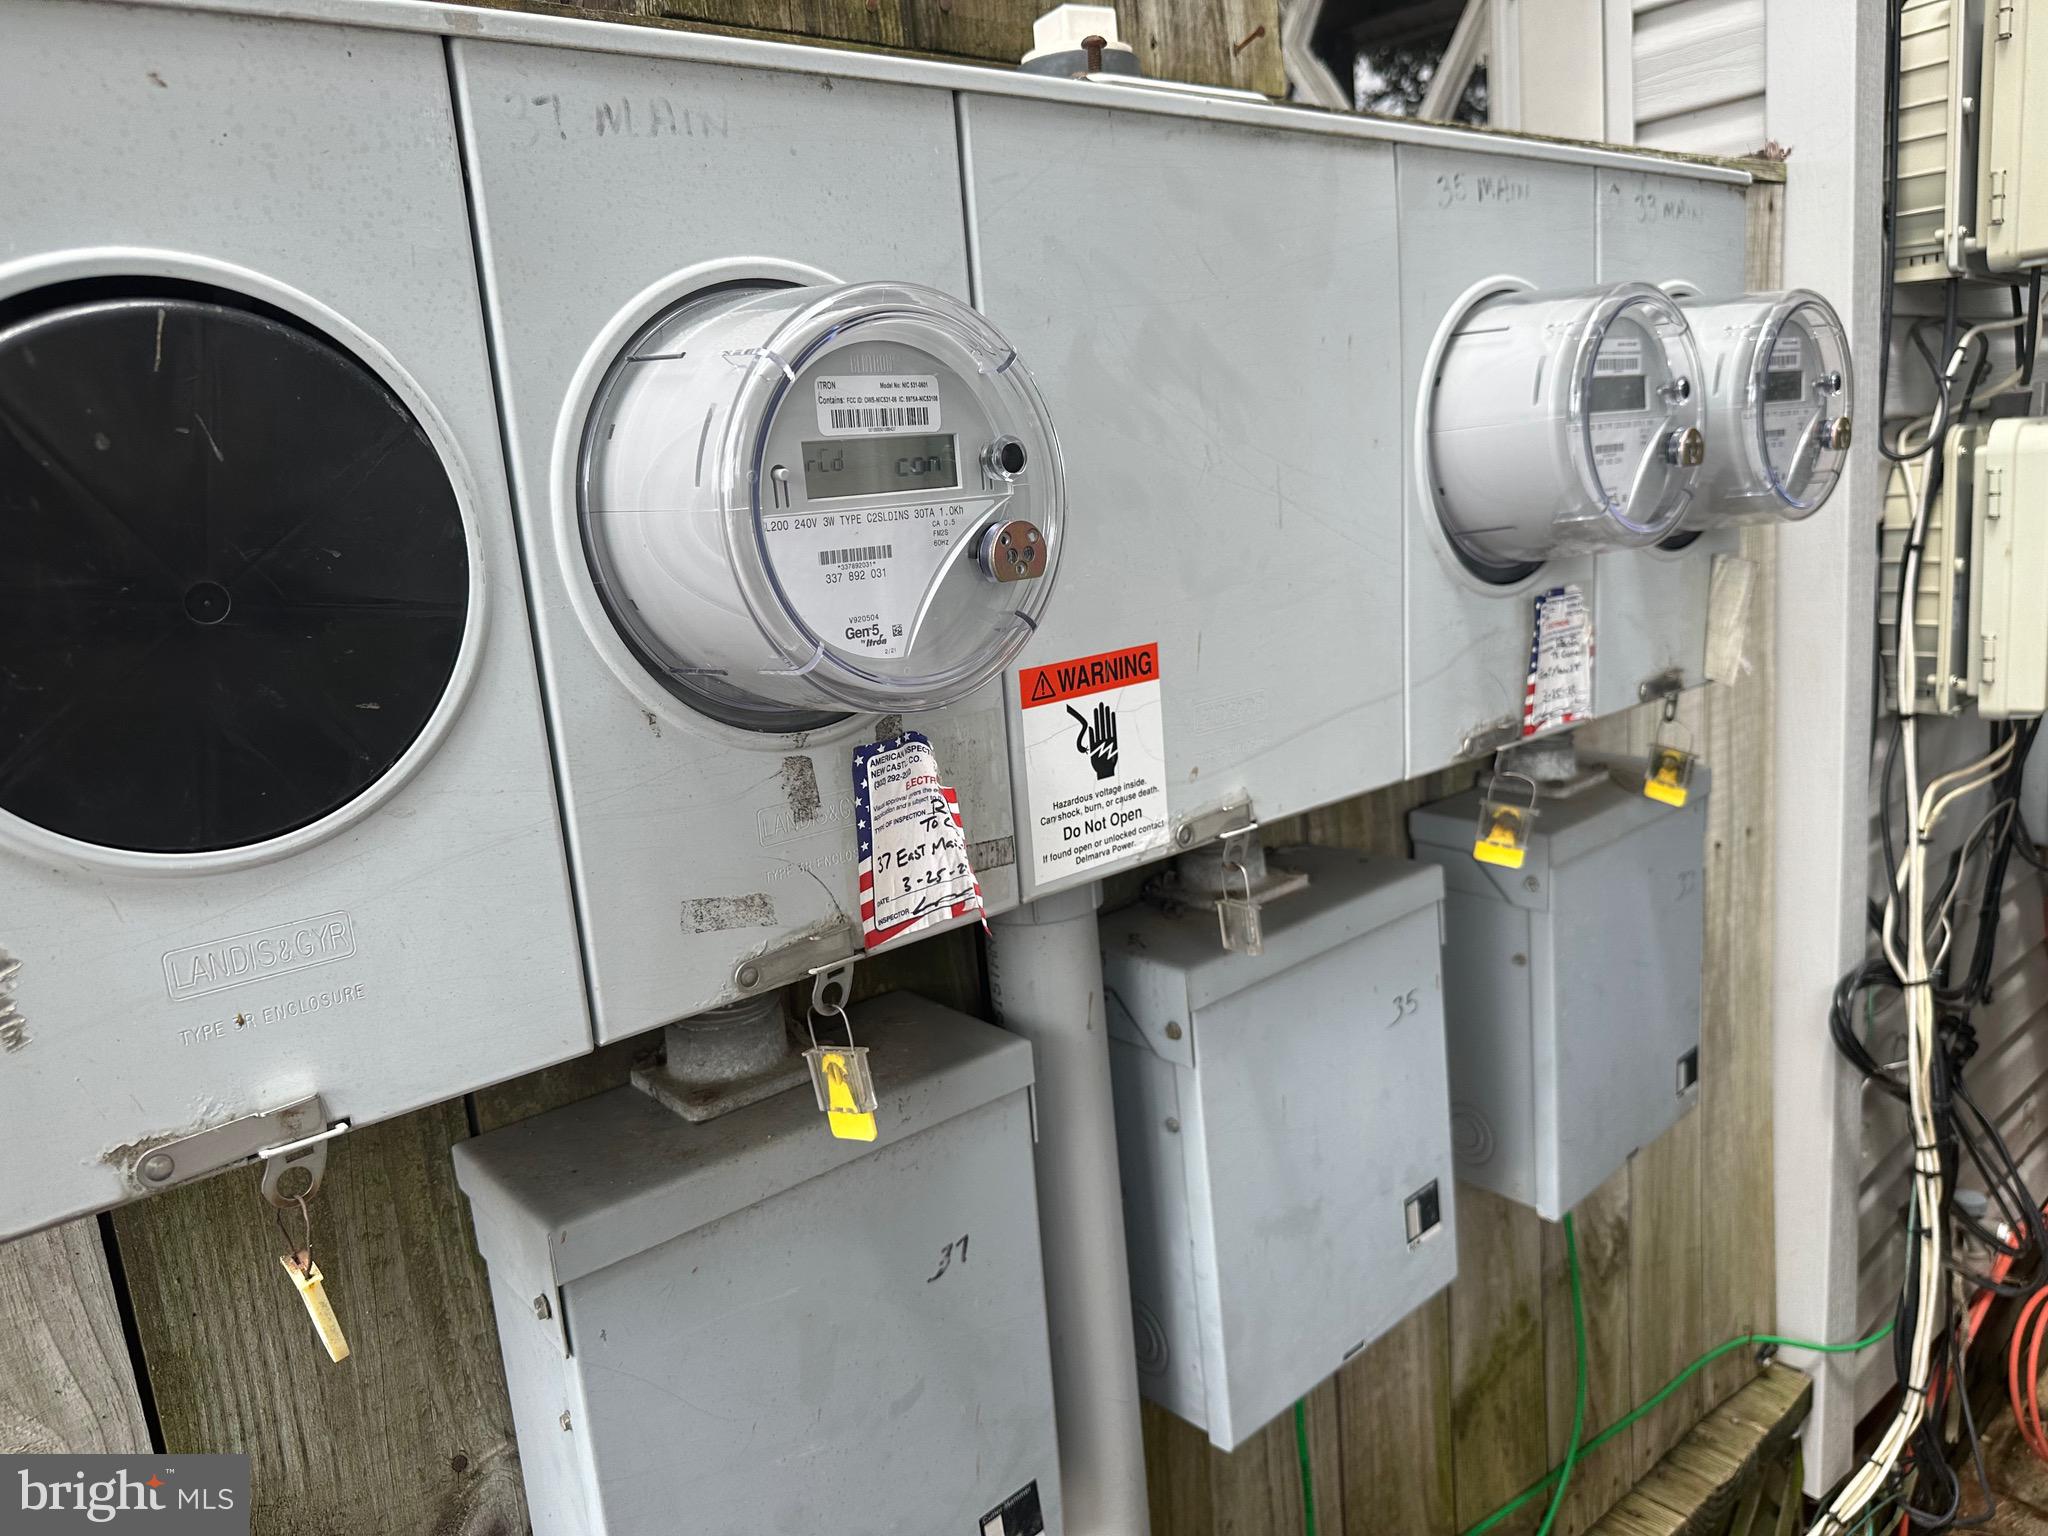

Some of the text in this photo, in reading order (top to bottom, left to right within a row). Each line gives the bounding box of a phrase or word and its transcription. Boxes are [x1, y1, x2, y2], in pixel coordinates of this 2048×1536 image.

[594, 96, 730, 138] MAIN
[817, 381, 836, 390] ITRON
[818, 395, 845, 405] Contains:
[794, 518, 817, 529] 240V
[823, 517, 835, 527] 3W
[841, 514, 861, 525] TYPE
[914, 507, 935, 519] 30TA
[939, 505, 964, 517] 1.0Kh
[932, 518, 956, 527] CA 0.5
[933, 529, 949, 537] FM2S
[825, 568, 887, 584] 337 892 031
[848, 613, 879, 624] V920504
[1057, 651, 1152, 693] WARNING
[870, 766, 886, 779] NEW
[908, 754, 922, 764] CO.
[1052, 777, 1148, 811] Hazardous voltage inside.
[1056, 806, 1083, 822] shock,
[1084, 801, 1104, 814] burn,
[1105, 798, 1114, 807] or
[1115, 793, 1136, 805] cause
[1137, 785, 1160, 798] death.
[885, 820, 894, 829] OF
[893, 809, 927, 826] INSPECTION
[1063, 807, 1143, 841] Do Not Open
[1042, 820, 1164, 864] If found open or unlocked contact
[1075, 840, 1137, 865] Delmarva Power.
[877, 852, 891, 874] 37
[896, 843, 926, 868] East
[877, 907, 910, 926] INSPECTOR
[179, 1020, 225, 1047] TYPE
[262, 983, 366, 1025] ENCLOSURE
[1386, 987, 1419, 1030] 35
[927, 1233, 969, 1284] 37
